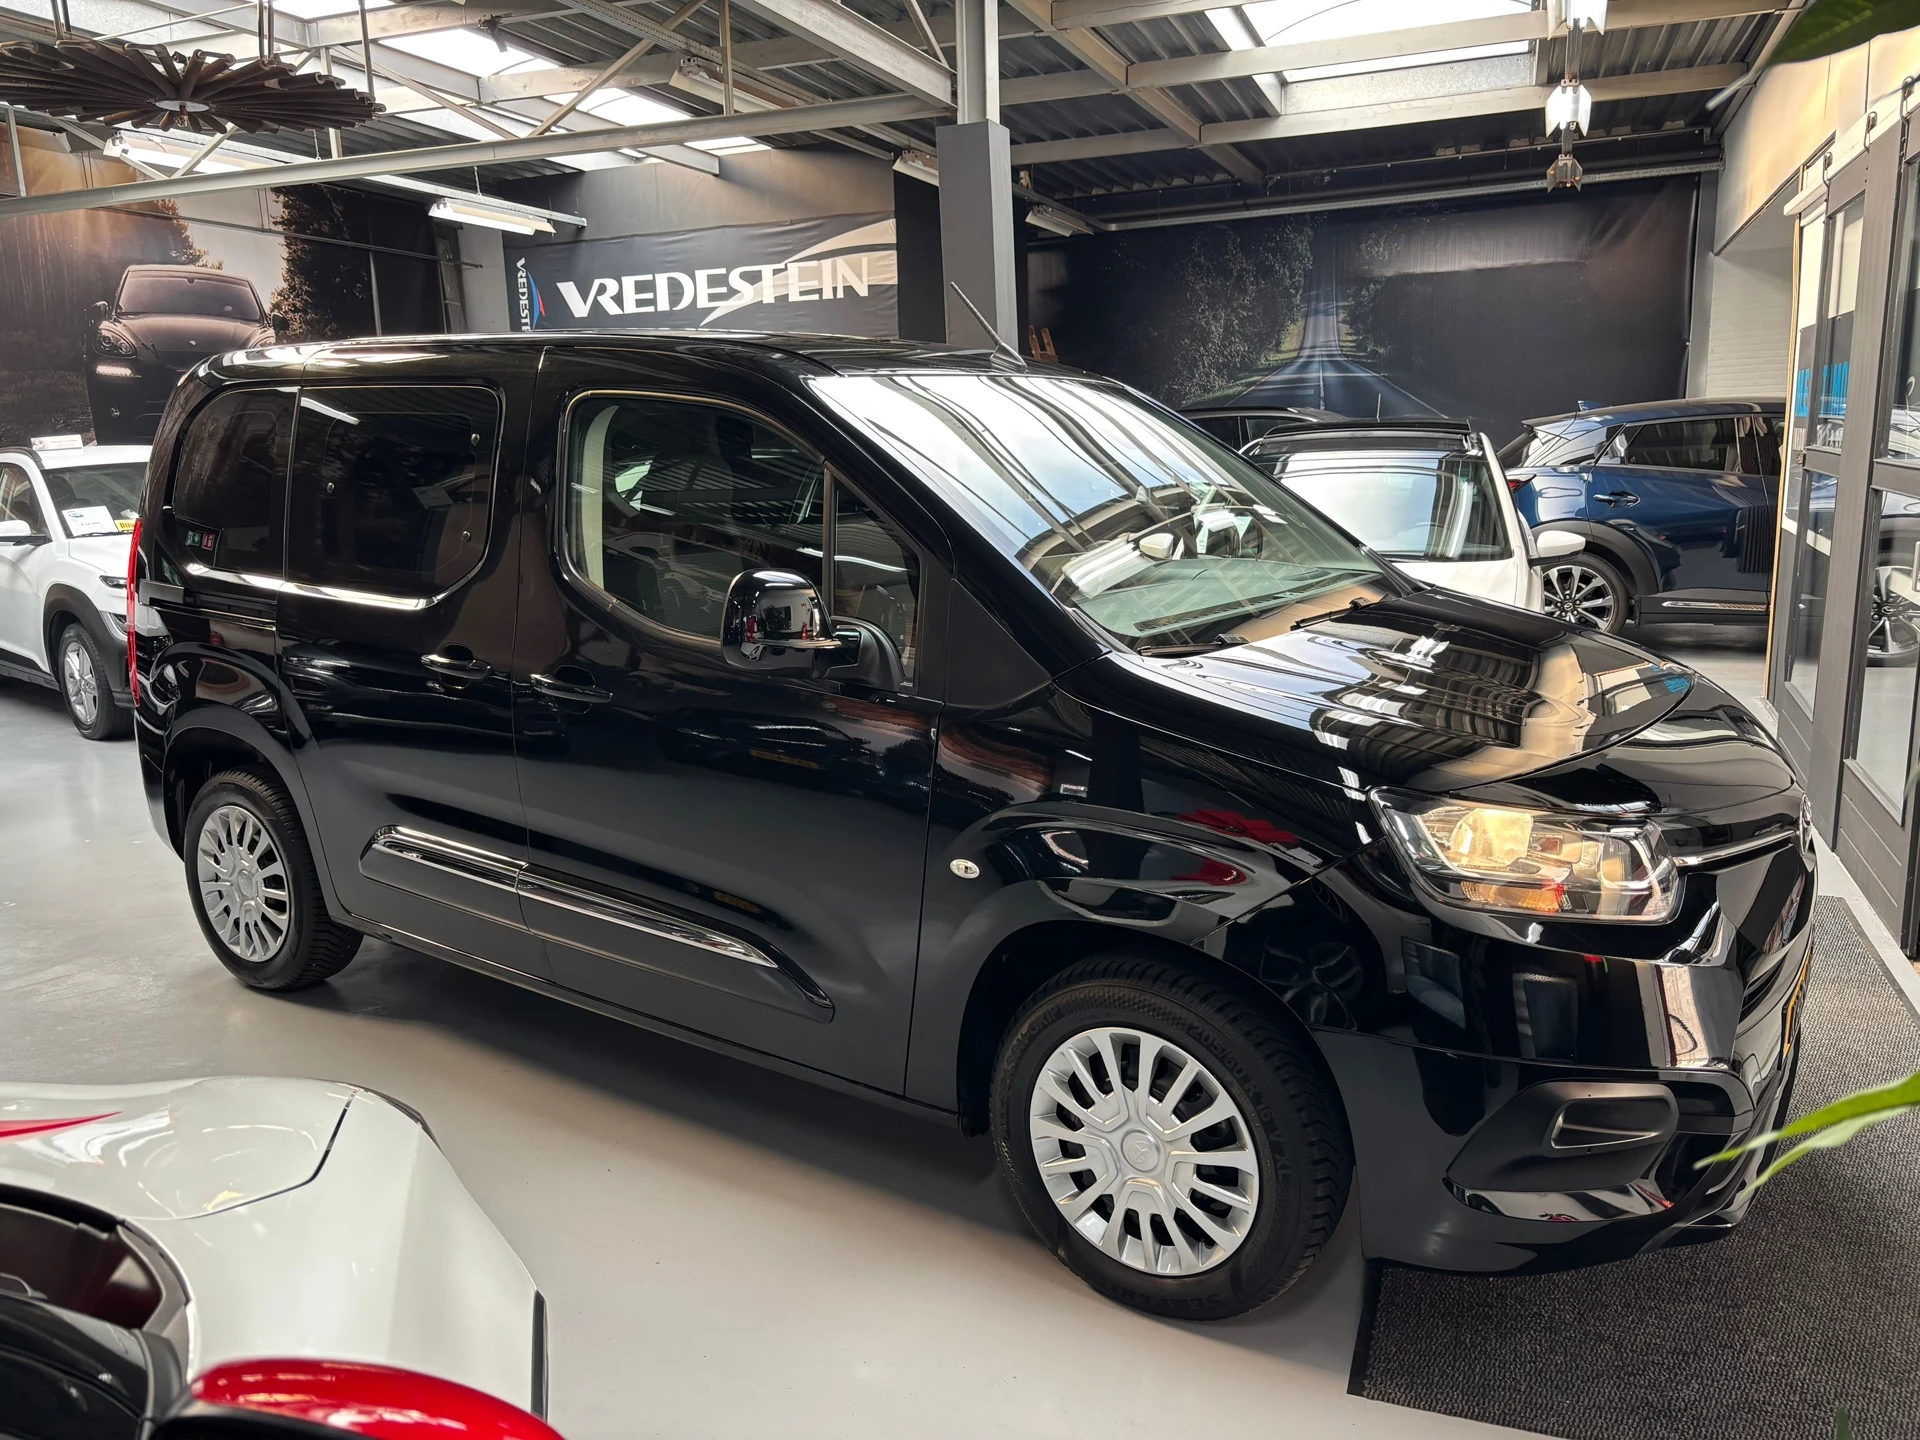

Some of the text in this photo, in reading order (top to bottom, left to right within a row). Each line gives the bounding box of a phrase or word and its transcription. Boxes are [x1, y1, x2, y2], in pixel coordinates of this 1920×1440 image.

[556, 256, 869, 318] VREDESTEIN
[1189, 1024, 1248, 1080] 205/60
[1256, 1101, 1274, 1121] 16
[1268, 1129, 1285, 1144] V
[1274, 1153, 1292, 1181] XL
